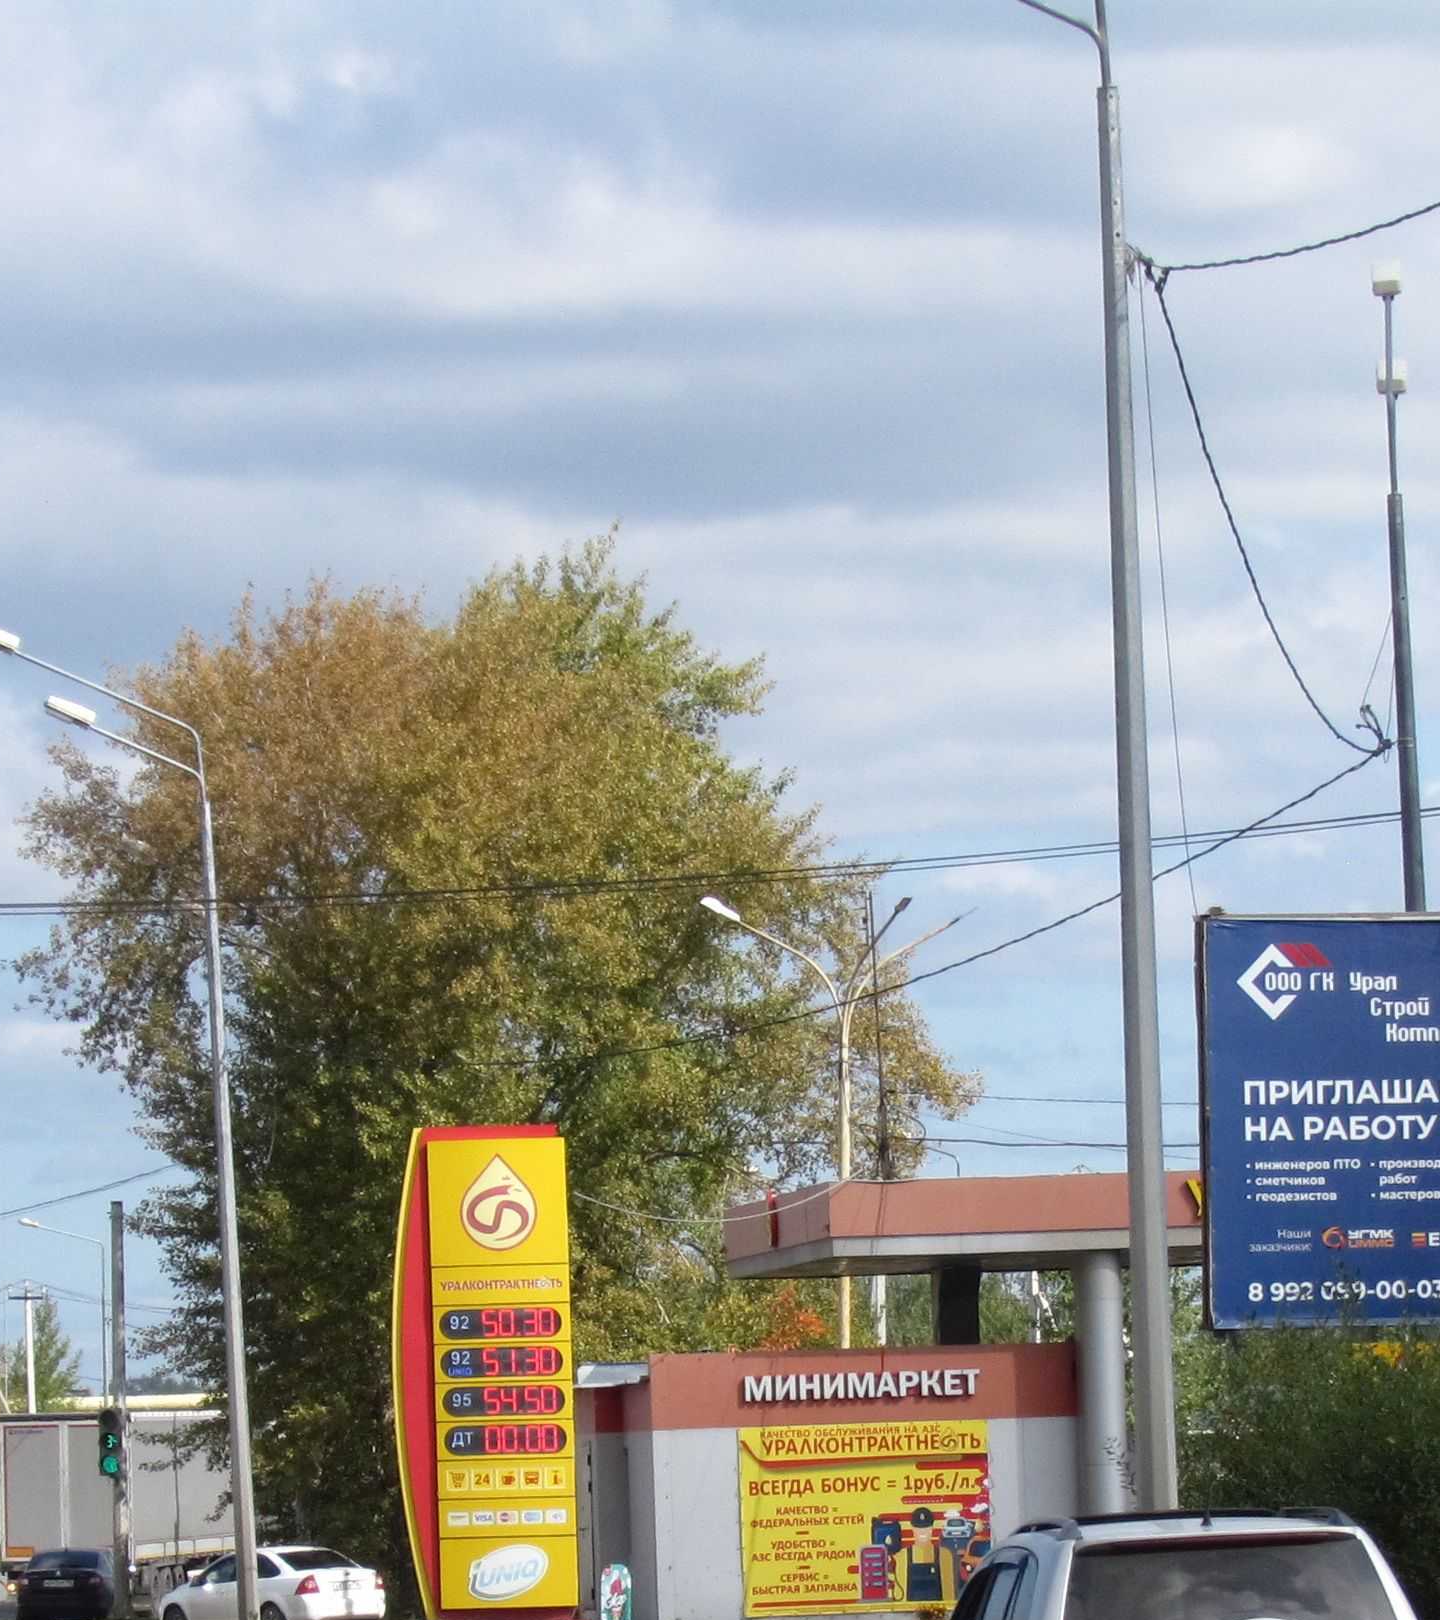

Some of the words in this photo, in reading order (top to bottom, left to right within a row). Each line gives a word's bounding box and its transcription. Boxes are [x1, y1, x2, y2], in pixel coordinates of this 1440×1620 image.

[1265, 971, 1302, 992] ООО
[1310, 971, 1335, 992] ГК
[1349, 971, 1398, 994] Урал
[1370, 997, 1430, 1019] Строй
[1244, 1116, 1295, 1141] НА
[1303, 1114, 1438, 1140] РАБОТУ
[1255, 1160, 1330, 1173] инженеров
[1333, 1158, 1361, 1171] ПТО
[1255, 1176, 1326, 1186] сметчиков
[1379, 1173, 1417, 1187] работ
[1255, 1191, 1337, 1203] геодезистов
[1379, 1190, 1440, 1202] мастеров
[1277, 1228, 1312, 1239] Наши
[1348, 1229, 1394, 1239] УГМК
[1248, 1282, 1264, 1302] 8
[1270, 1281, 1314, 1302] 992
[449, 1315, 470, 1330] 92
[481, 1307, 556, 1337] 50.30
[450, 1350, 471, 1366] 92
[743, 1368, 981, 1402] МИНИМАРКЕТ
[452, 1393, 472, 1408] 95
[761, 1428, 811, 1440] КАЧЕСТВО
[815, 1426, 900, 1438] ОБСЛУЖИВАНИЯ
[904, 1424, 918, 1434] НА
[922, 1424, 941, 1434] АЗС
[451, 1431, 474, 1449] ДТ
[474, 1473, 490, 1485] 24
[748, 1478, 814, 1498] ВСЕГДА
[821, 1475, 881, 1493] БОНУС
[776, 1505, 829, 1516] КАЧЕСТВО
[474, 1513, 493, 1523] VISA
[750, 1516, 830, 1529] ФЕДЕРАЛЬНЫХ
[833, 1514, 865, 1526] СЕТЕЙ
[771, 1539, 826, 1551] УДОБСТВО
[751, 1551, 773, 1562] АЗС
[775, 1550, 813, 1562] ВСЕГДА
[816, 1549, 857, 1561] РЯДОМ
[780, 1572, 821, 1583] СЕРВИС
[752, 1584, 800, 1596] БЫСТРАЯ
[804, 1583, 859, 1594] ЗАПРАВКА
